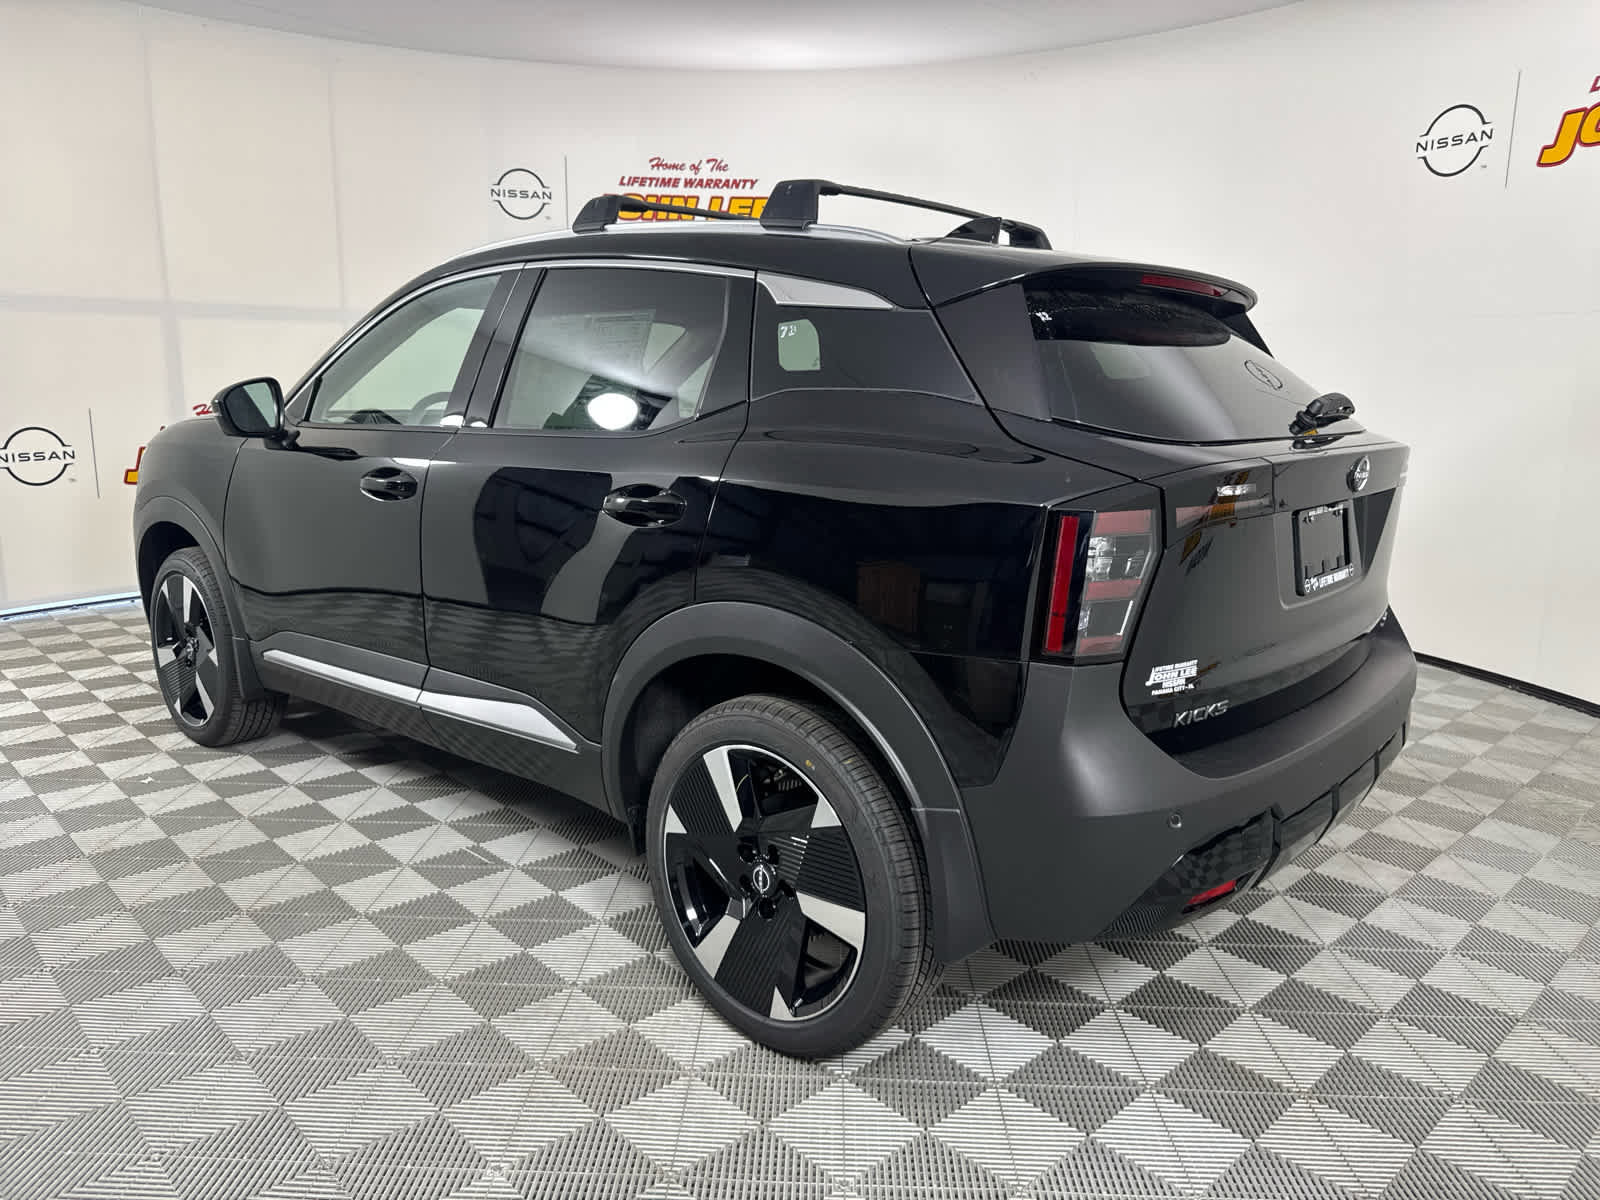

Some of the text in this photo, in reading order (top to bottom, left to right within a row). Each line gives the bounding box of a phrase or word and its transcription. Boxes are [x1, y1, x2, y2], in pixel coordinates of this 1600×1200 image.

[1415, 128, 1494, 153] NISSAN
[649, 157, 729, 174] Home of The
[618, 176, 759, 190] LIFETIME WARRANTY
[490, 188, 552, 200] NISSAN
[1173, 699, 1229, 728] KICKS
